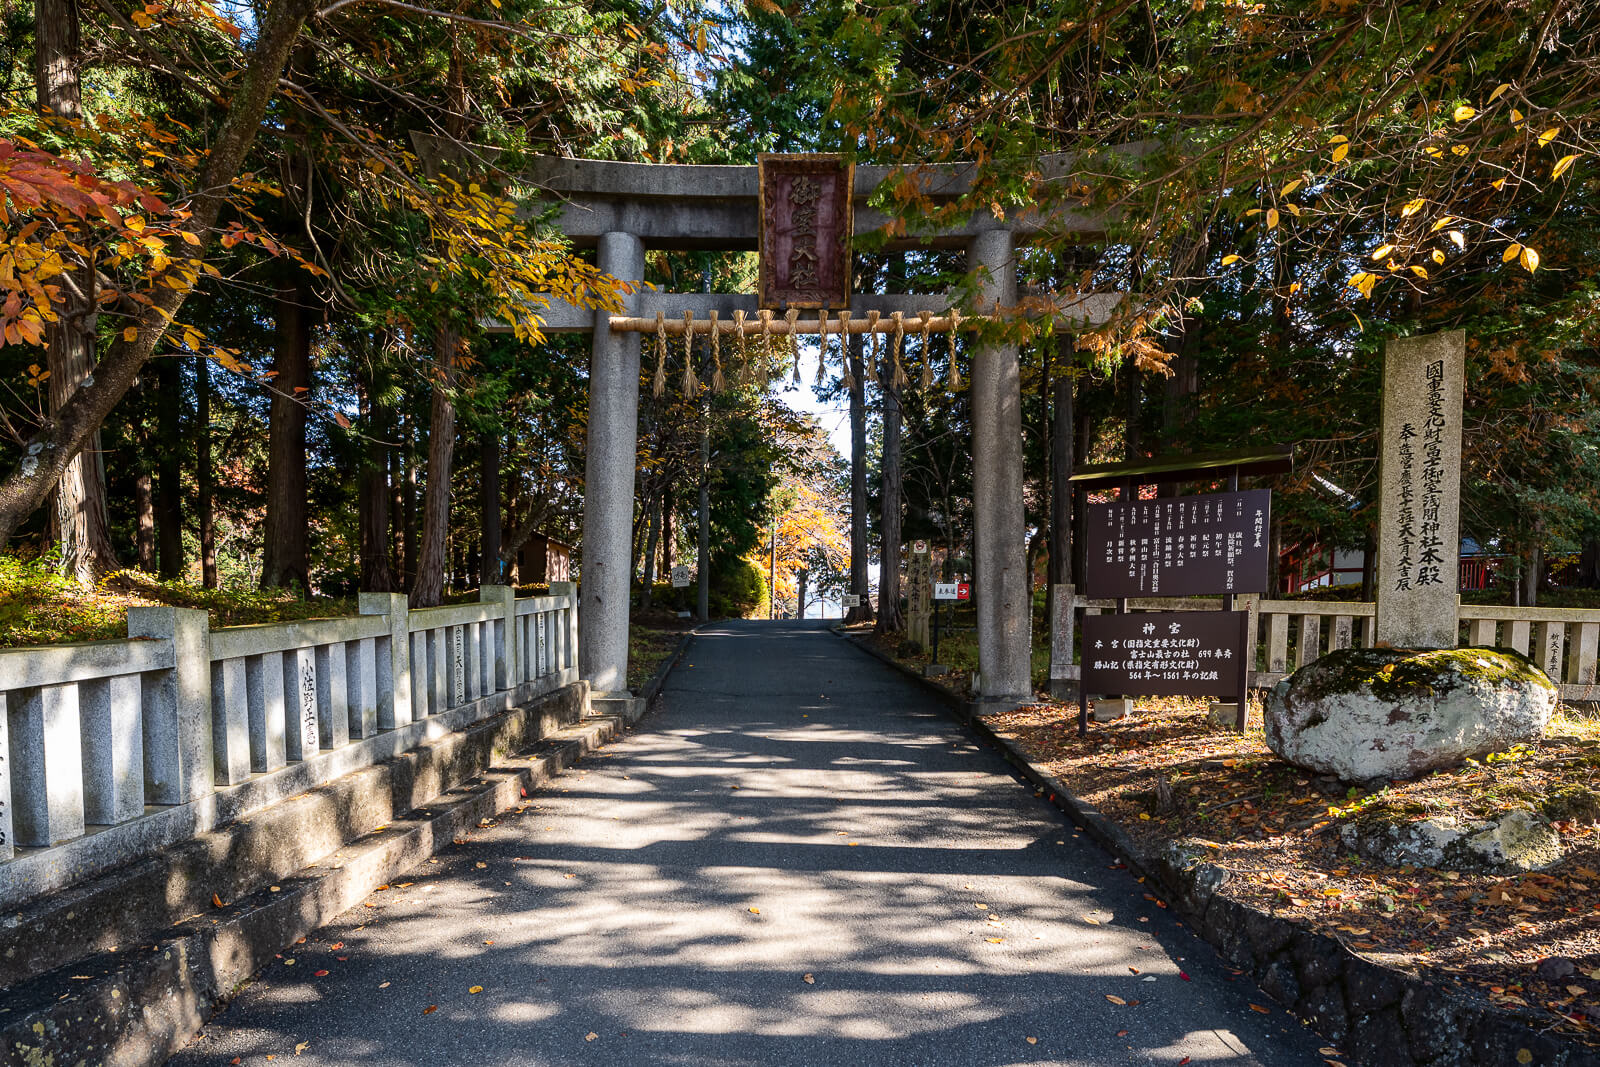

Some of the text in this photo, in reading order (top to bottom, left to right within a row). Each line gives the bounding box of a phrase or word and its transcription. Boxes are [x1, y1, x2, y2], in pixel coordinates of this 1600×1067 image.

[1130, 649, 1190, 659] 富士山最古の社
